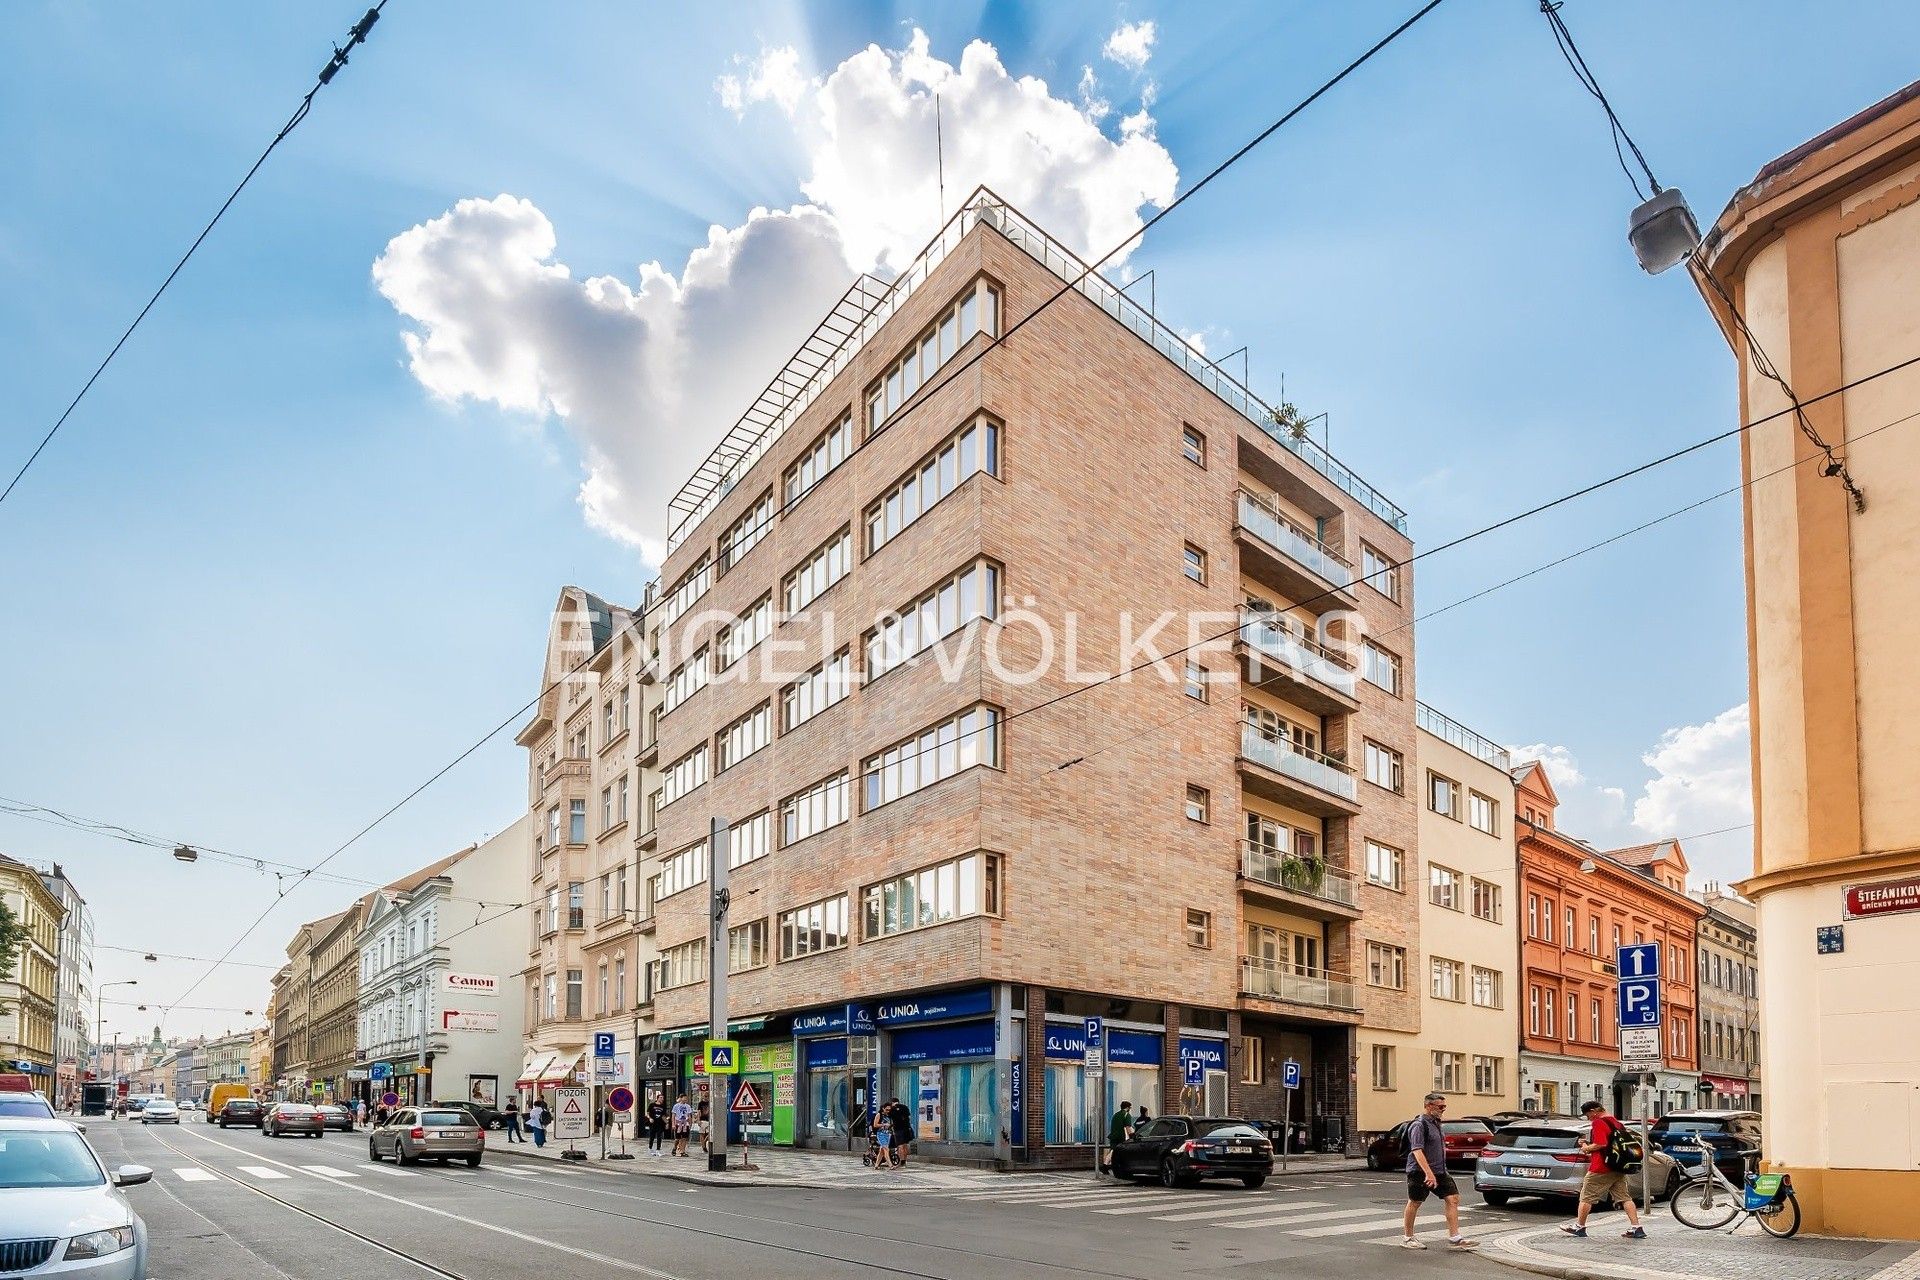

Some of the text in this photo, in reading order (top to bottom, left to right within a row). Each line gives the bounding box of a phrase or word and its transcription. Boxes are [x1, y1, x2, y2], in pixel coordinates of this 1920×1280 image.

[449, 975, 493, 987] Canon
[1627, 985, 1650, 1011] P
[890, 1004, 919, 1018] UNIQA
[803, 1016, 826, 1028] UNIQA
[852, 1023, 875, 1031] UNIQA
[1088, 1022, 1098, 1038] P
[600, 1036, 610, 1049] P
[1064, 1039, 1086, 1051] UNI
[1189, 1061, 1200, 1076] P
[1287, 1066, 1296, 1080] P
